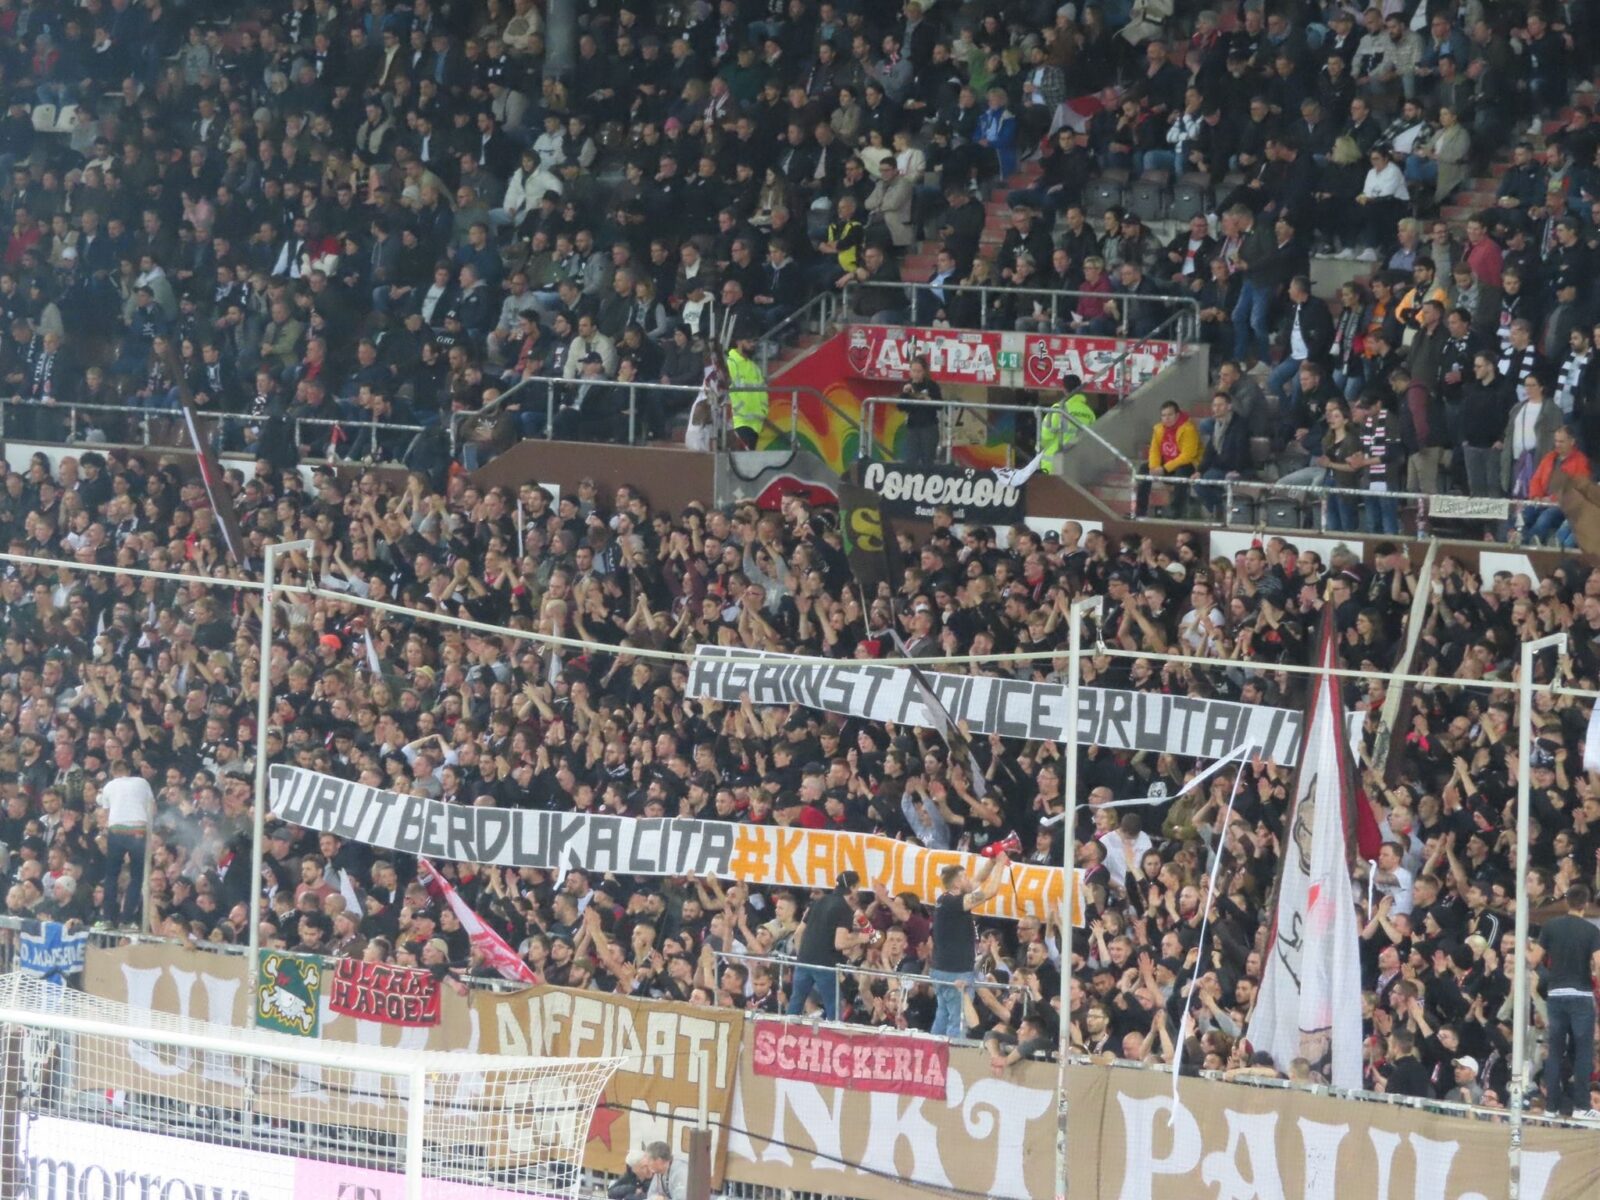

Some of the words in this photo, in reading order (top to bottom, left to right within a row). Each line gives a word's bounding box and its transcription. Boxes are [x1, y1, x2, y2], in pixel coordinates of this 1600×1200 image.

[876, 338, 996, 376] ASTRA
[1054, 349, 1175, 387] ASTR
[694, 646, 894, 718] AGAINST
[898, 669, 1065, 741] POLICE
[1074, 686, 1354, 766] BRUTALIT
[270, 768, 396, 843] TURUT
[730, 825, 1085, 926] #KANJURHAN
[332, 977, 436, 1022] HAPOEL
[496, 991, 729, 1089] DIFFIDATI
[755, 1030, 946, 1087] SCHICKERIA
